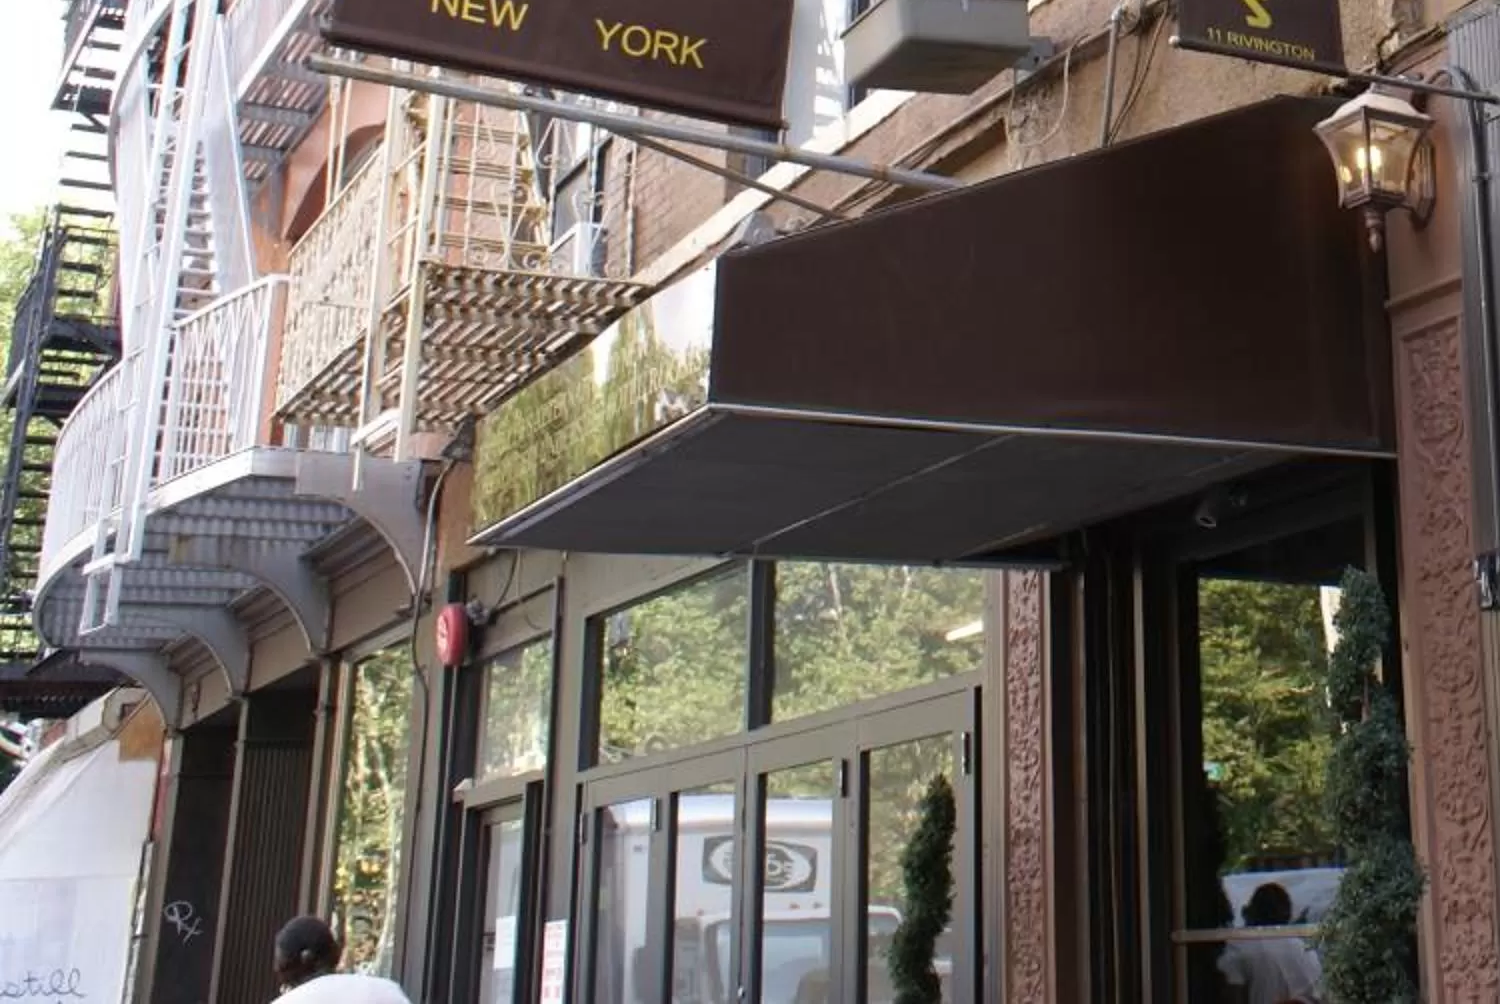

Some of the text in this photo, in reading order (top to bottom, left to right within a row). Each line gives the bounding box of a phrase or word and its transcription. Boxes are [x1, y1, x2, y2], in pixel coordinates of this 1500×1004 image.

[594, 18, 707, 70] YORK
[1206, 27, 1315, 61] 11 RIVINGTON
